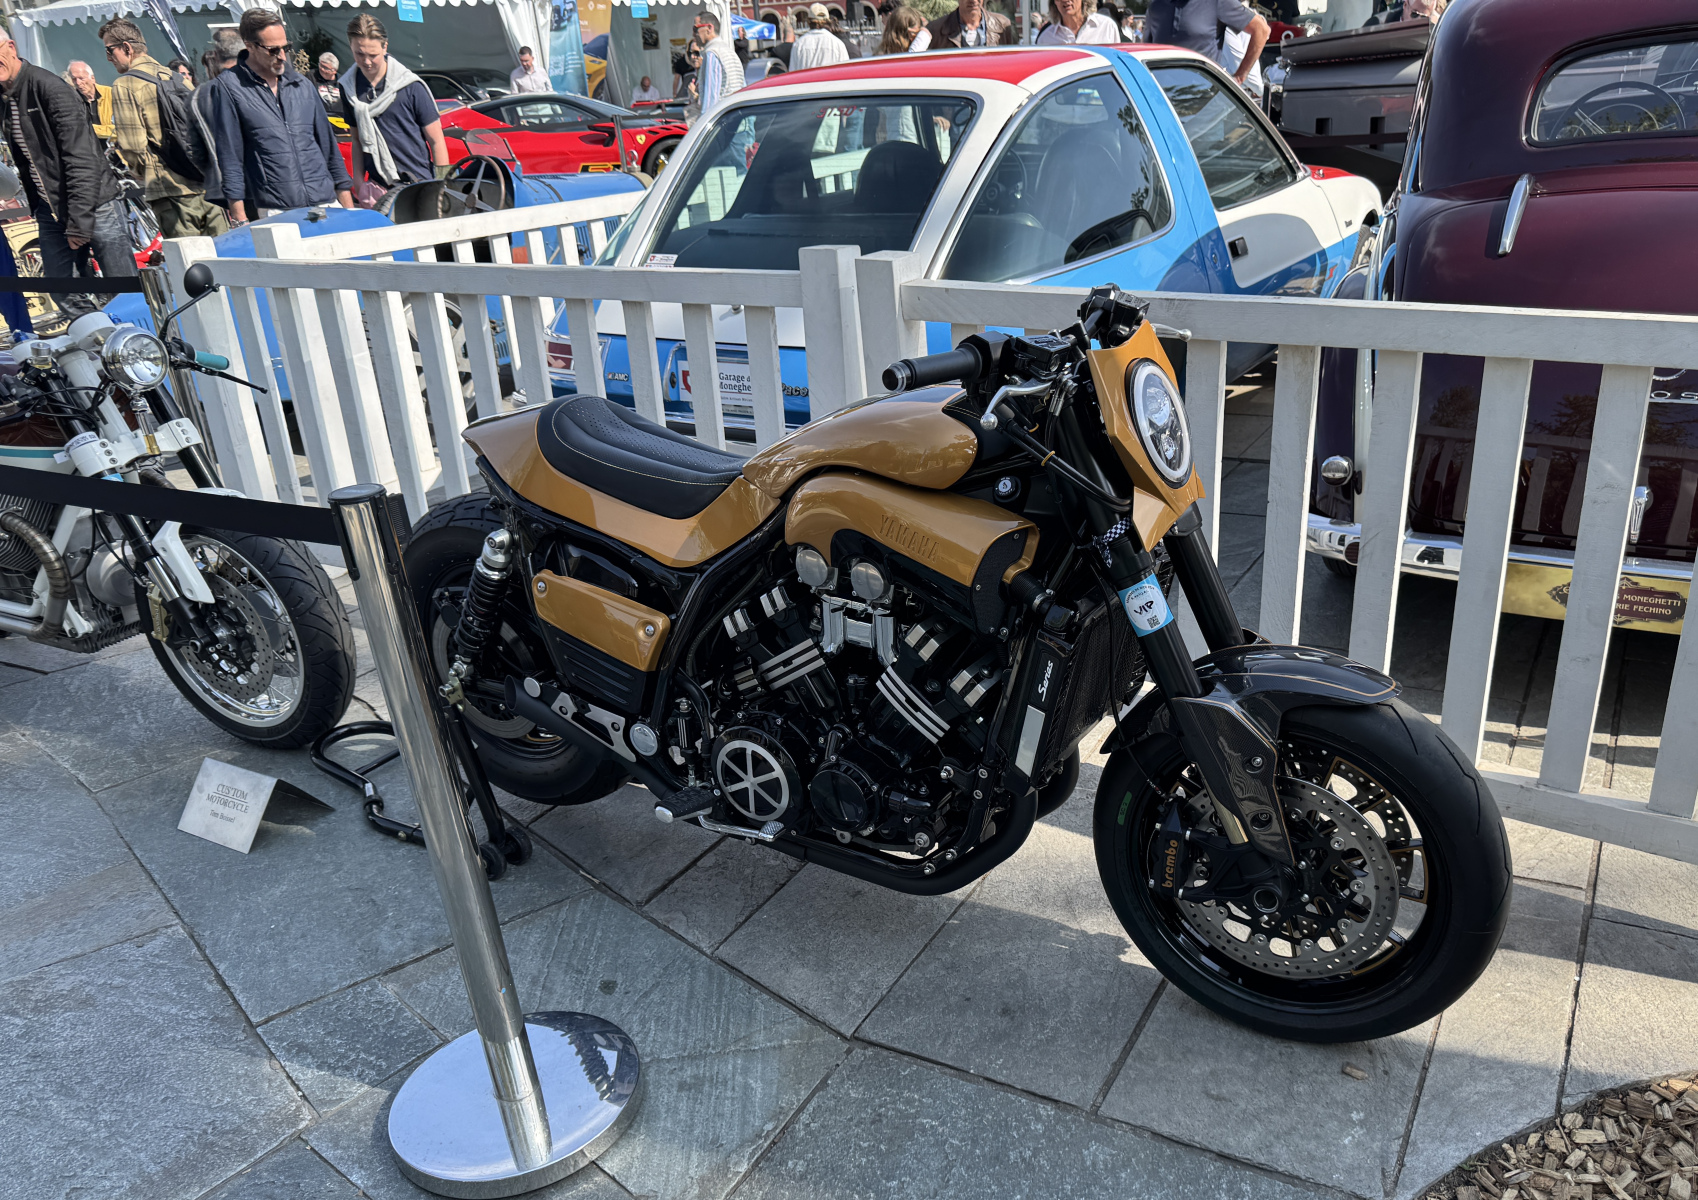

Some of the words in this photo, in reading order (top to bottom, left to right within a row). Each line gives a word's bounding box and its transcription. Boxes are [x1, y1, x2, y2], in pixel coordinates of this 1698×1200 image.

[615, 372, 629, 382] AMC
[719, 372, 745, 383] Garage
[781, 383, 809, 397] ace
[880, 514, 940, 564] YAMAHA
[1133, 600, 1154, 616] VIP
[1623, 594, 1681, 607] MONEGHETTI
[1633, 604, 1672, 615] FECHINO
[216, 783, 249, 801] CUSTOM
[206, 793, 249, 813] MOTORCYCLE
[1162, 839, 1178, 888] brembo
